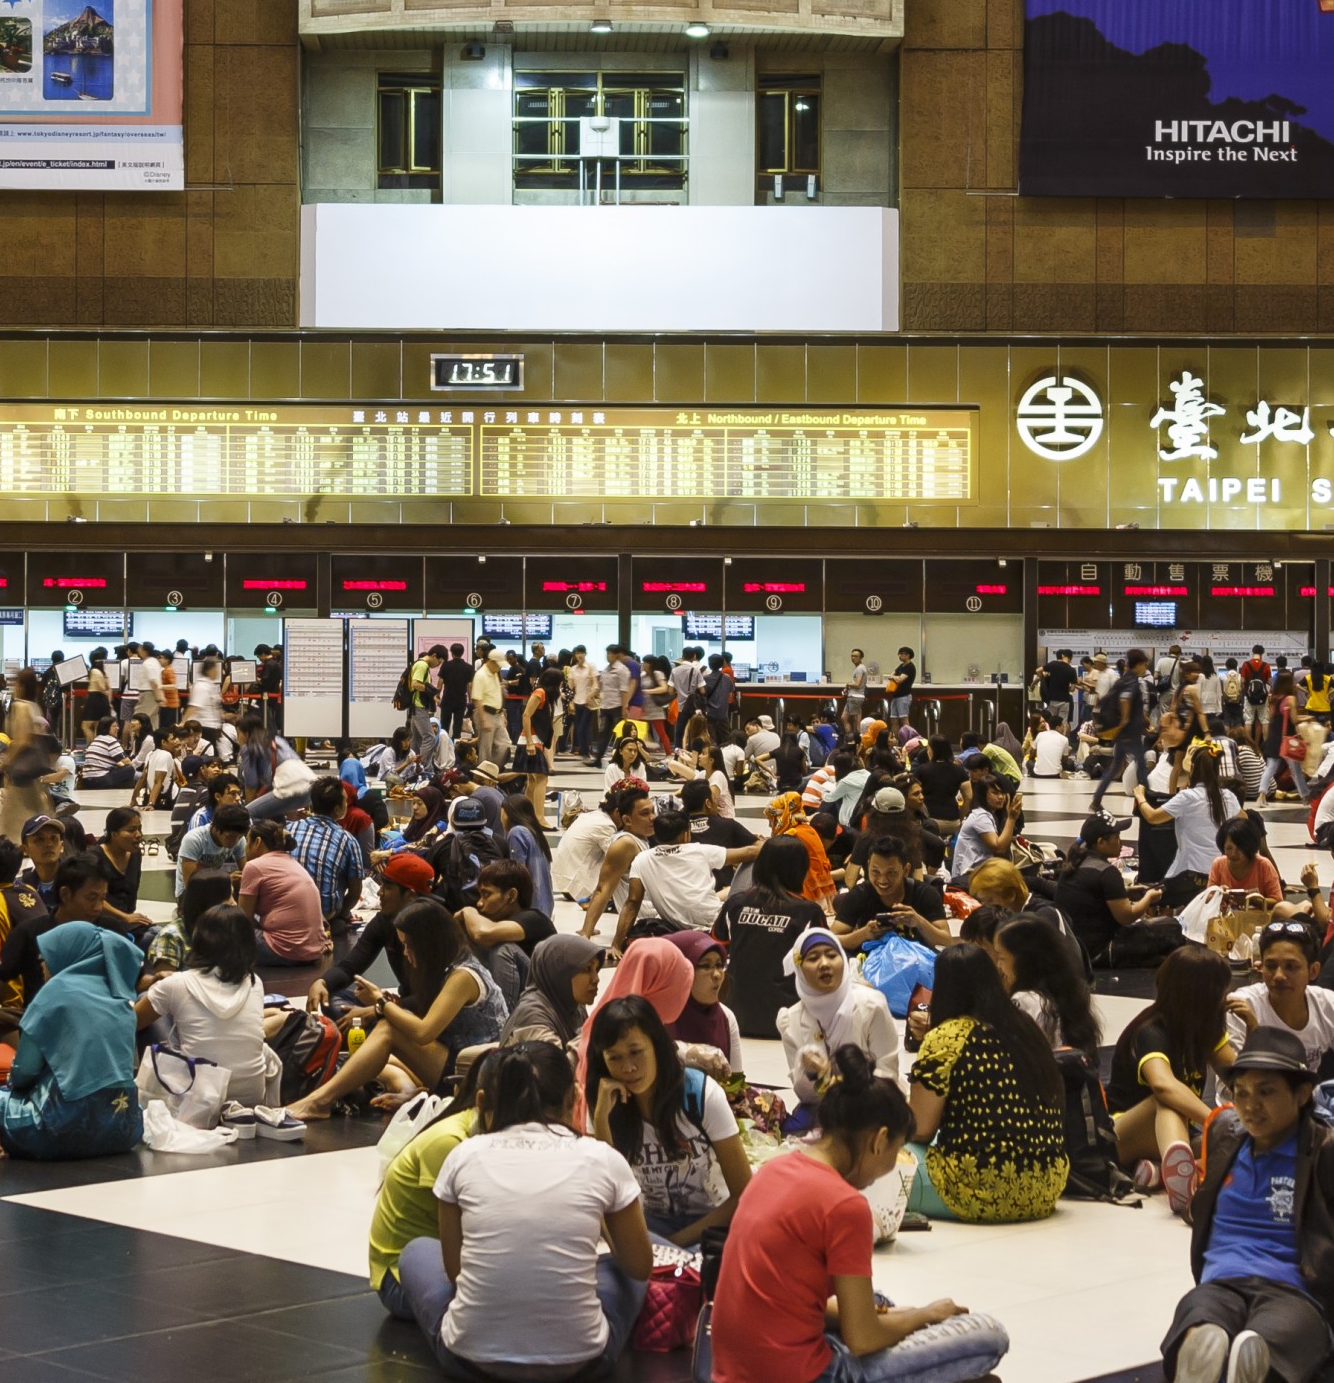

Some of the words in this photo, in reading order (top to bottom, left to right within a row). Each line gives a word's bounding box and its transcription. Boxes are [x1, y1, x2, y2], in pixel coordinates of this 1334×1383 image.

[1155, 120, 1289, 143] HITACHI
[1146, 147, 1212, 164] Inspire
[1217, 147, 1248, 161] the
[1253, 146, 1298, 162] Next
[452, 363, 511, 381] 17:51
[85, 409, 167, 420] Southbound
[172, 410, 240, 422] Departure
[245, 410, 278, 421] Time
[676, 413, 701, 424] 北上
[707, 413, 772, 424] Northbound
[781, 414, 840, 424] Eastbound
[843, 414, 897, 427] Departure
[899, 414, 927, 425] Time
[1158, 478, 1280, 503] TAIPEI
[1080, 563, 1274, 582] 自動售票機
[738, 912, 791, 928] DUCATI
